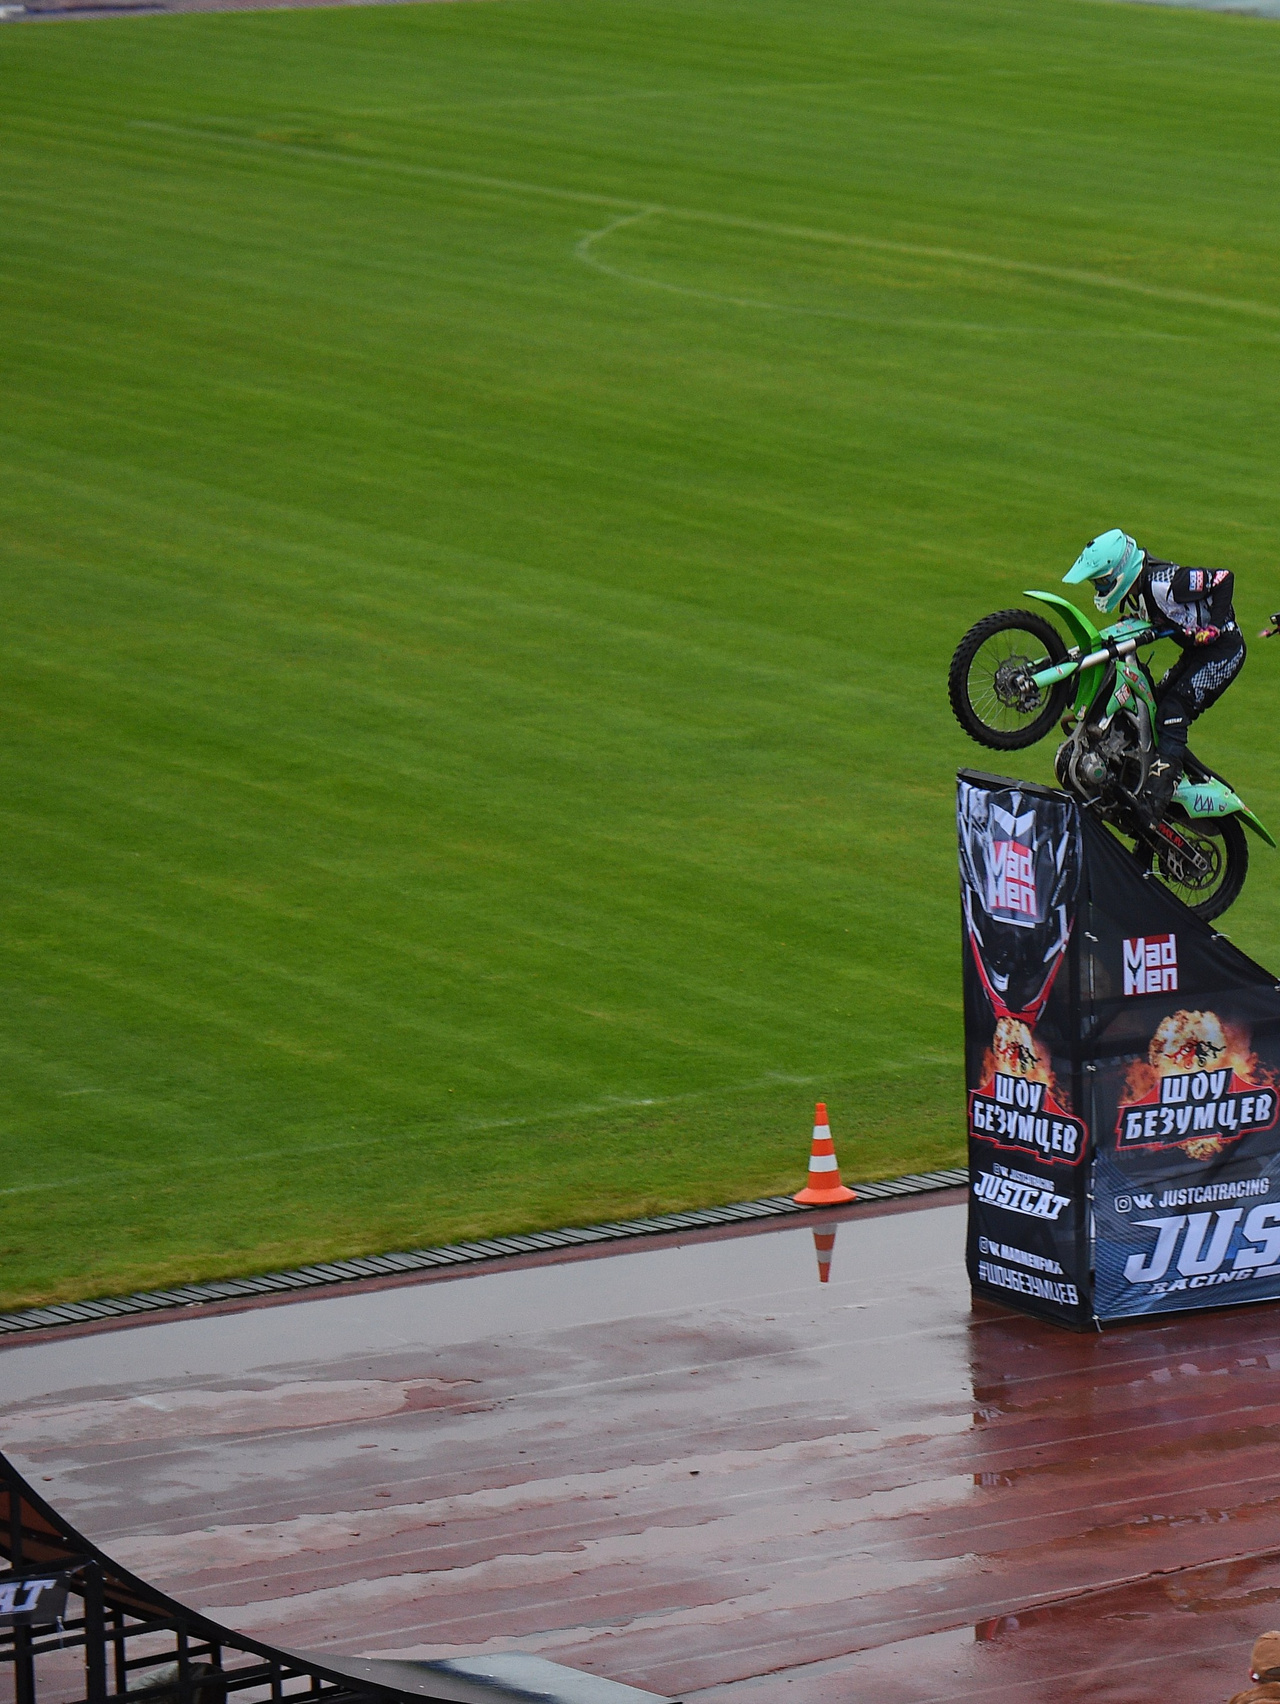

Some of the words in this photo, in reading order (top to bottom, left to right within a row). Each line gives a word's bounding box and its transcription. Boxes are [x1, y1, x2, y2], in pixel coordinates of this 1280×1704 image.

[1122, 933, 1177, 968] Mad
[1123, 966, 1178, 995] Men
[995, 1074, 1042, 1113] ШОУ
[1161, 1070, 1227, 1104] ШОУ
[973, 1100, 1078, 1154] БЕЗУМЦЕВ
[1125, 1093, 1273, 1139] БЕЗУМЦЕВ
[973, 1170, 1072, 1219] JUSTCAT
[1158, 1177, 1270, 1208] JUSTCATRACING
[978, 1259, 1080, 1305] #ШОУБЕЗУМЦЕВ
[1147, 1268, 1254, 1294] RACING
